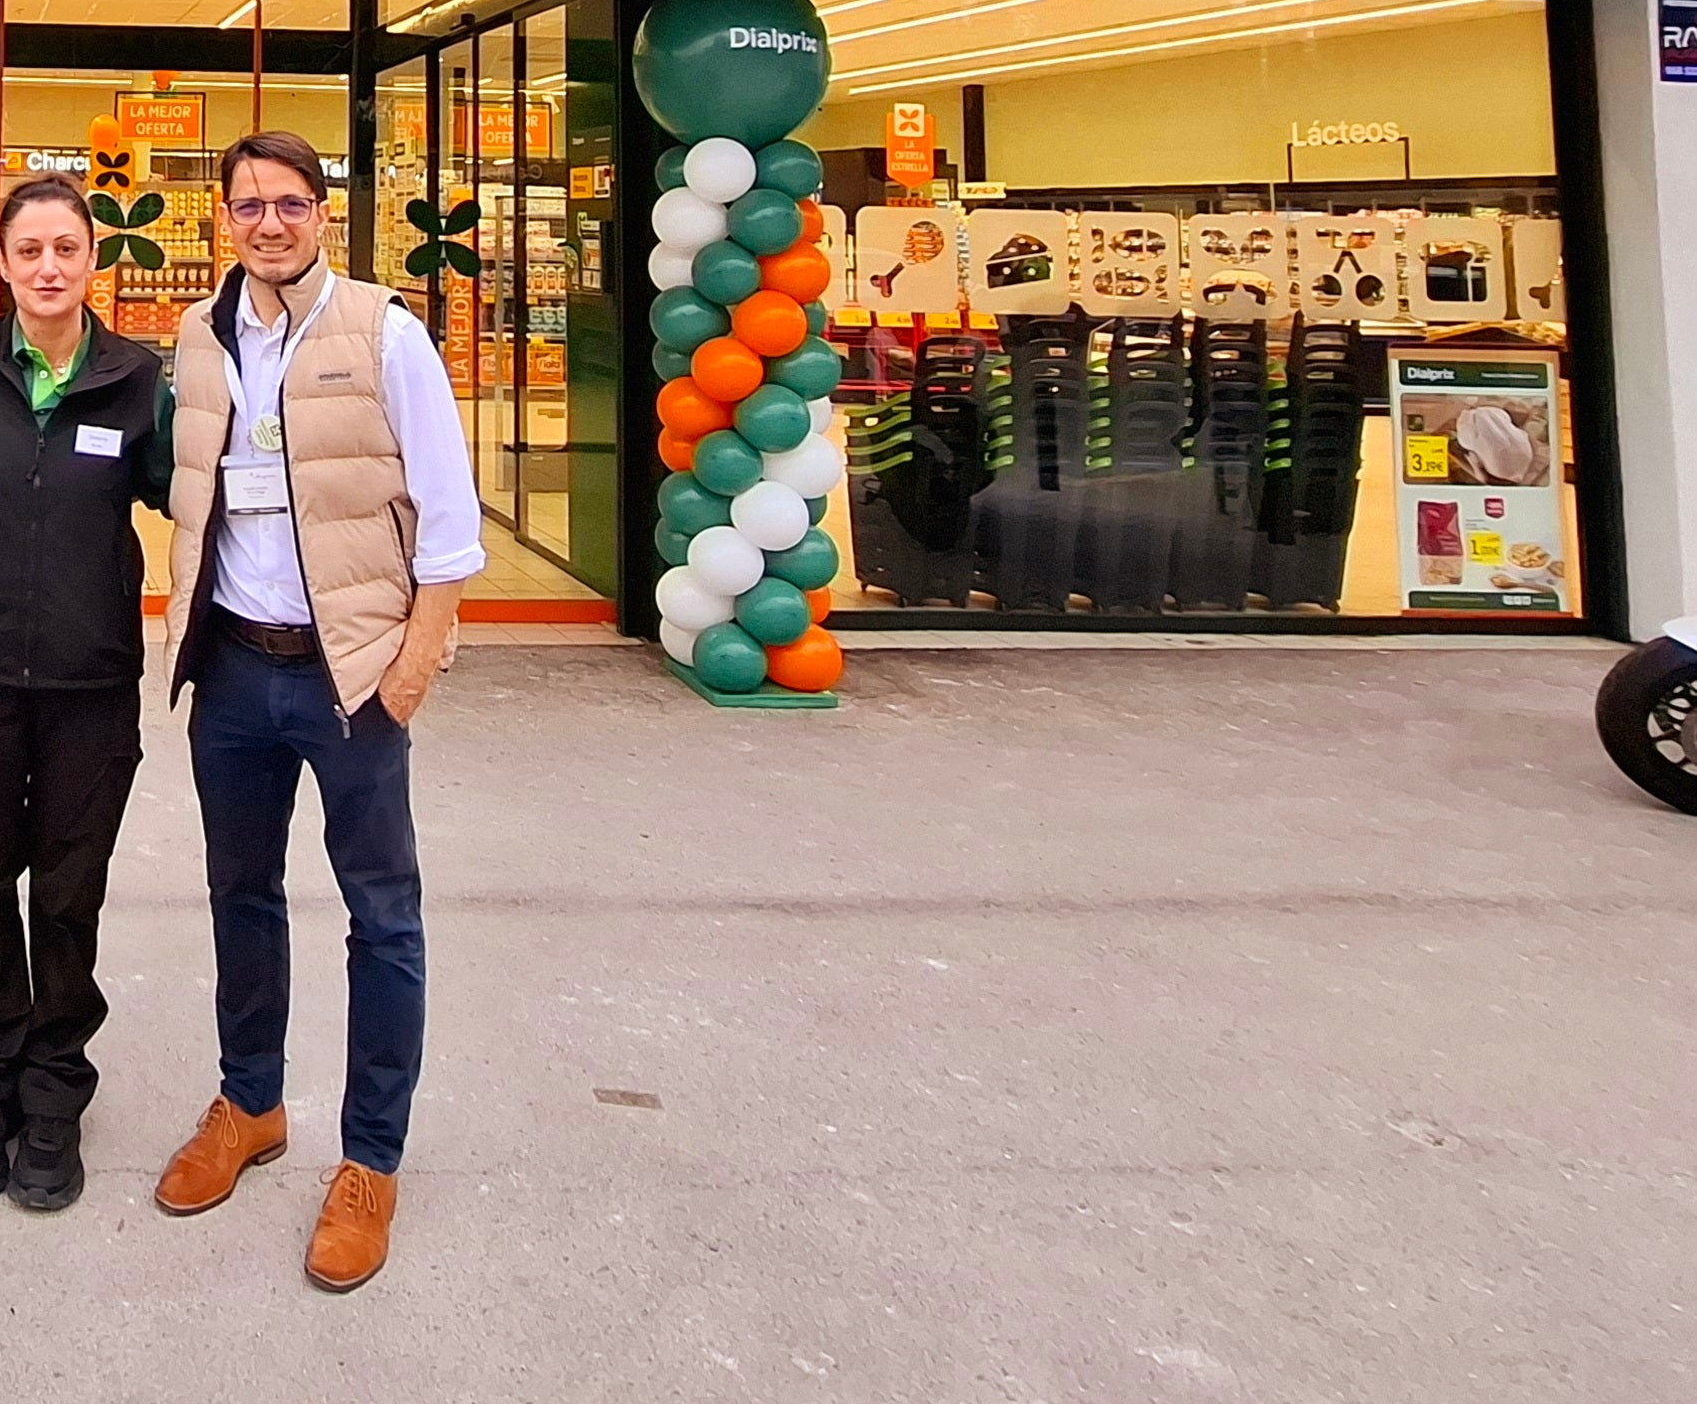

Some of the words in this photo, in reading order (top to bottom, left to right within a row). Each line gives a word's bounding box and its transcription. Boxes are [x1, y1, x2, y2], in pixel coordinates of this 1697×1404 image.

[729, 27, 817, 53] Dialprix
[1663, 26, 1697, 48] RA
[130, 105, 145, 118] LA
[149, 105, 191, 119] MEJOR
[135, 122, 184, 136] OFERTA
[1292, 119, 1401, 147] Lácteos
[451, 285, 470, 353] MEJOR
[451, 358, 470, 383] LA
